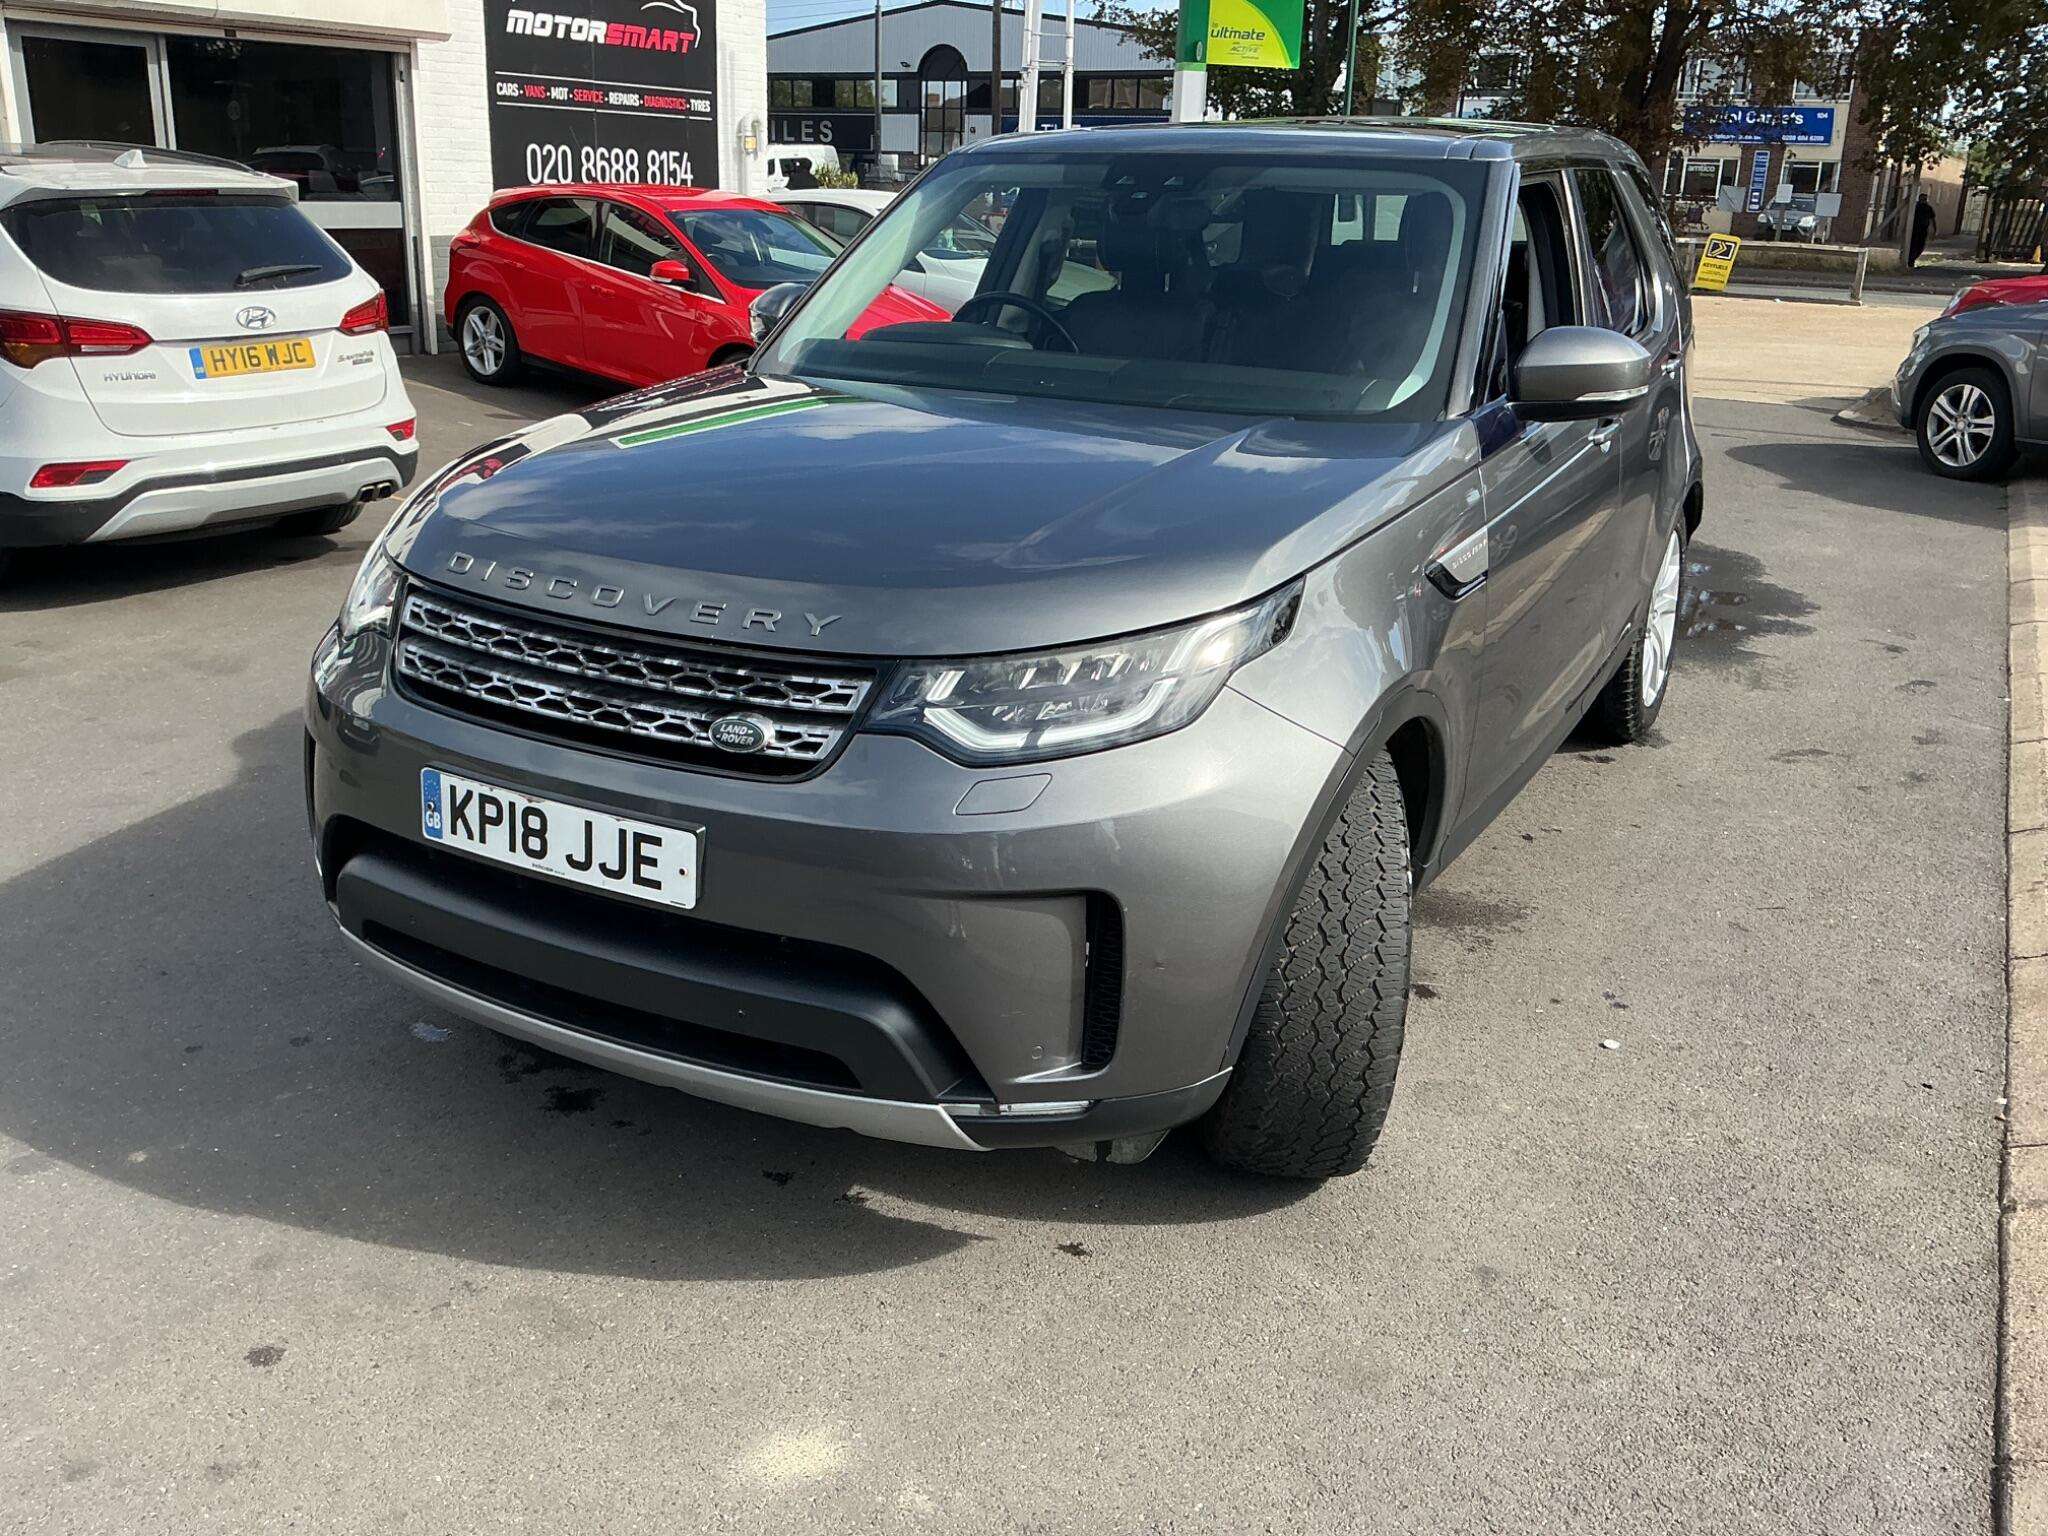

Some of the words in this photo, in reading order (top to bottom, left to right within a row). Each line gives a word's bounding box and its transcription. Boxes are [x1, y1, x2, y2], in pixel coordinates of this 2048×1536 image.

[506, 9, 695, 54] MOTORSMART
[1210, 26, 1266, 41] ultimate
[496, 82, 519, 97] CARS
[524, 84, 546, 98] VANS
[550, 86, 569, 100] MOT
[573, 88, 604, 104] SERVICE
[608, 91, 640, 107] REPAIRS
[643, 95, 687, 110] DIAGNOSTICS
[689, 98, 711, 112] TYRES
[526, 143, 574, 185] 020
[580, 146, 640, 185] 8688
[646, 149, 694, 187] 8154
[1687, 164, 1716, 173] amtico
[210, 345, 262, 372] HY16
[266, 342, 307, 366] WJC
[103, 371, 157, 382] HYUNDAI
[447, 551, 843, 637] DISCOVERY
[426, 811, 442, 830] GB
[449, 784, 549, 861] KP18
[565, 819, 663, 891] JJE
